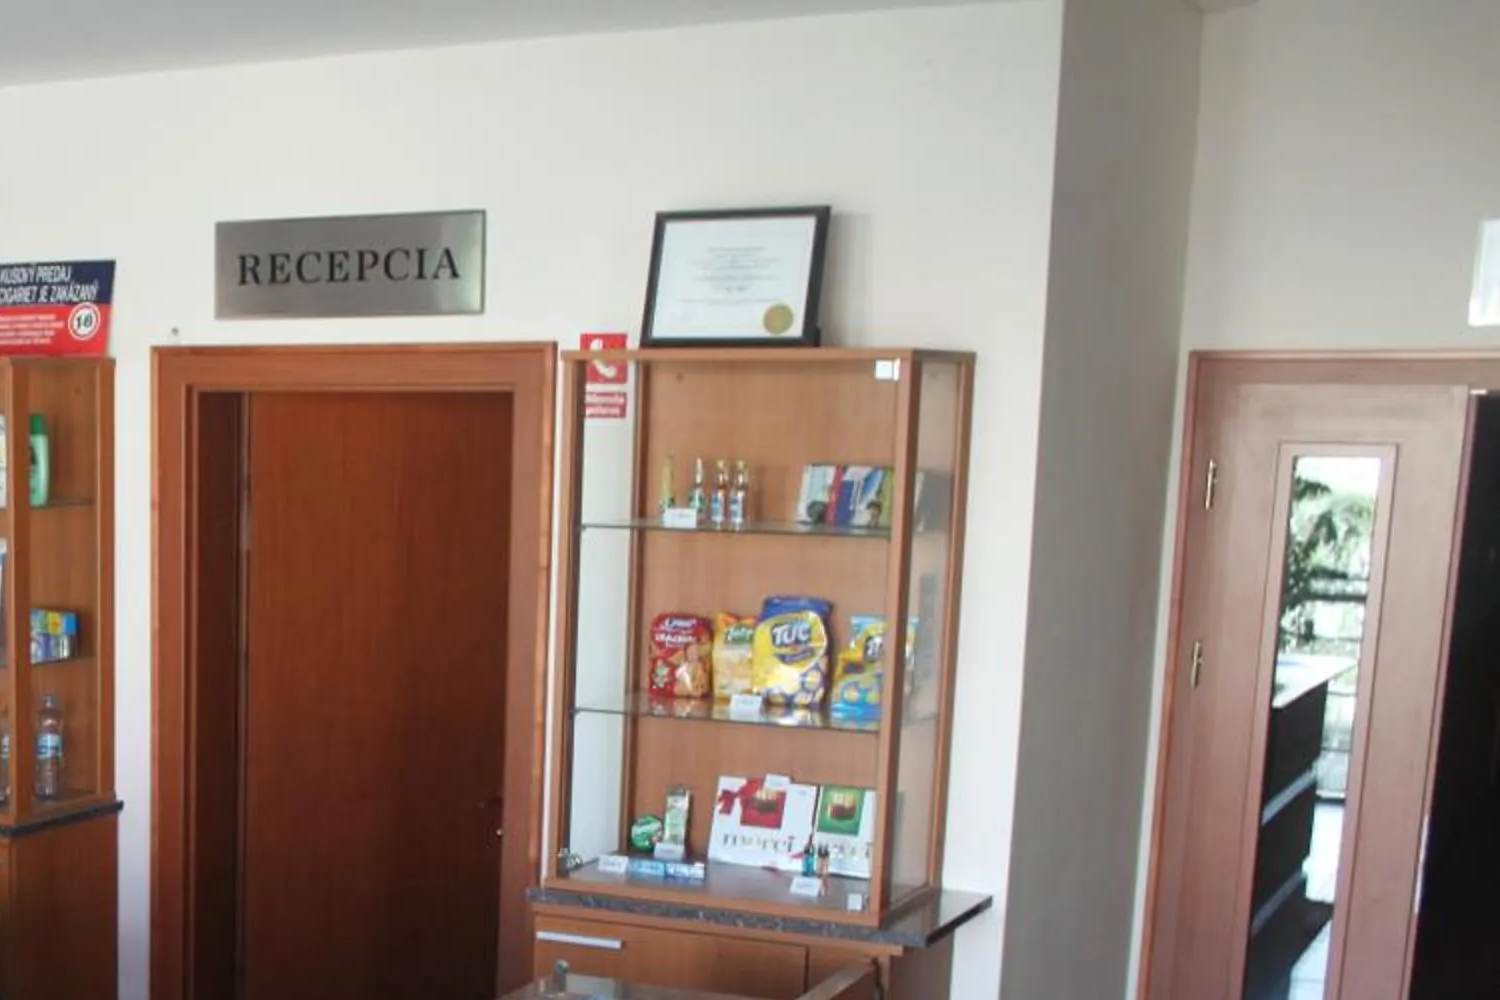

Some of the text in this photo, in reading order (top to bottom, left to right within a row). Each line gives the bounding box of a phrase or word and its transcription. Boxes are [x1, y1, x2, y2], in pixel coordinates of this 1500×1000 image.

[36, 264, 72, 283] PREDAJ
[237, 246, 461, 286] RECEPCIA
[38, 285, 49, 303] JE
[76, 314, 93, 329] 18
[771, 620, 811, 646] TUC
[722, 834, 796, 853] merci
